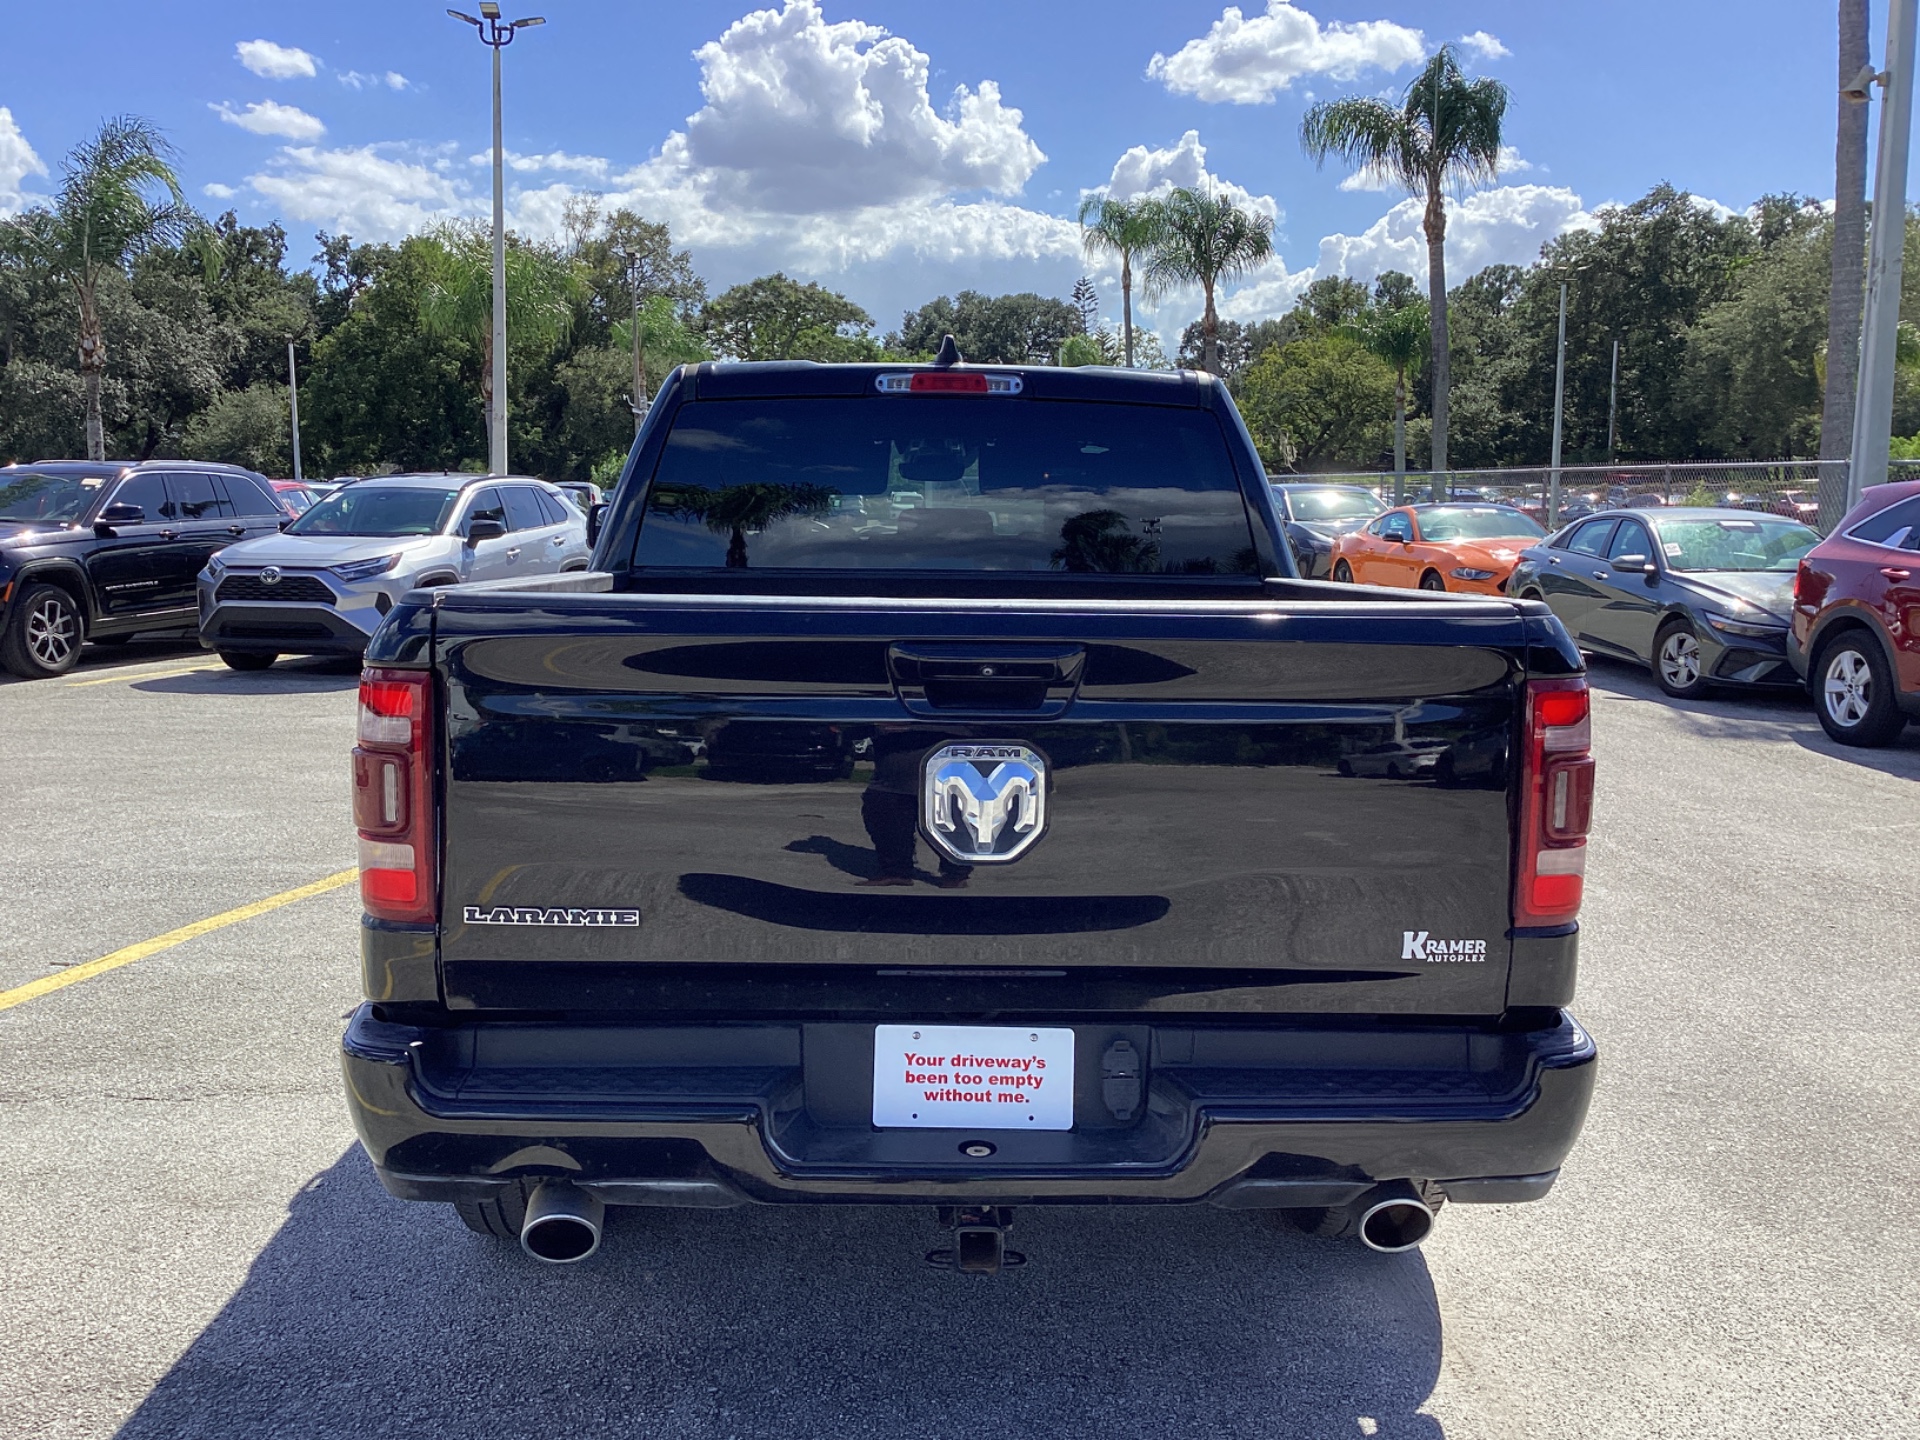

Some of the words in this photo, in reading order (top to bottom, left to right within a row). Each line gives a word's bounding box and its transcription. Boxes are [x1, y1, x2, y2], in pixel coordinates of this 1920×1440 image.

[951, 747, 1021, 757] RAM
[464, 906, 640, 927] LARAMIE
[1401, 931, 1486, 959] KRAMER
[1426, 954, 1486, 962] AUTOPLEX
[904, 1052, 945, 1067] Your
[950, 1054, 1046, 1072] driveway's
[905, 1070, 948, 1084] been
[954, 1072, 983, 1085] too
[988, 1074, 1043, 1089] empty
[924, 1088, 992, 1102] without
[998, 1092, 1030, 1103] me.
